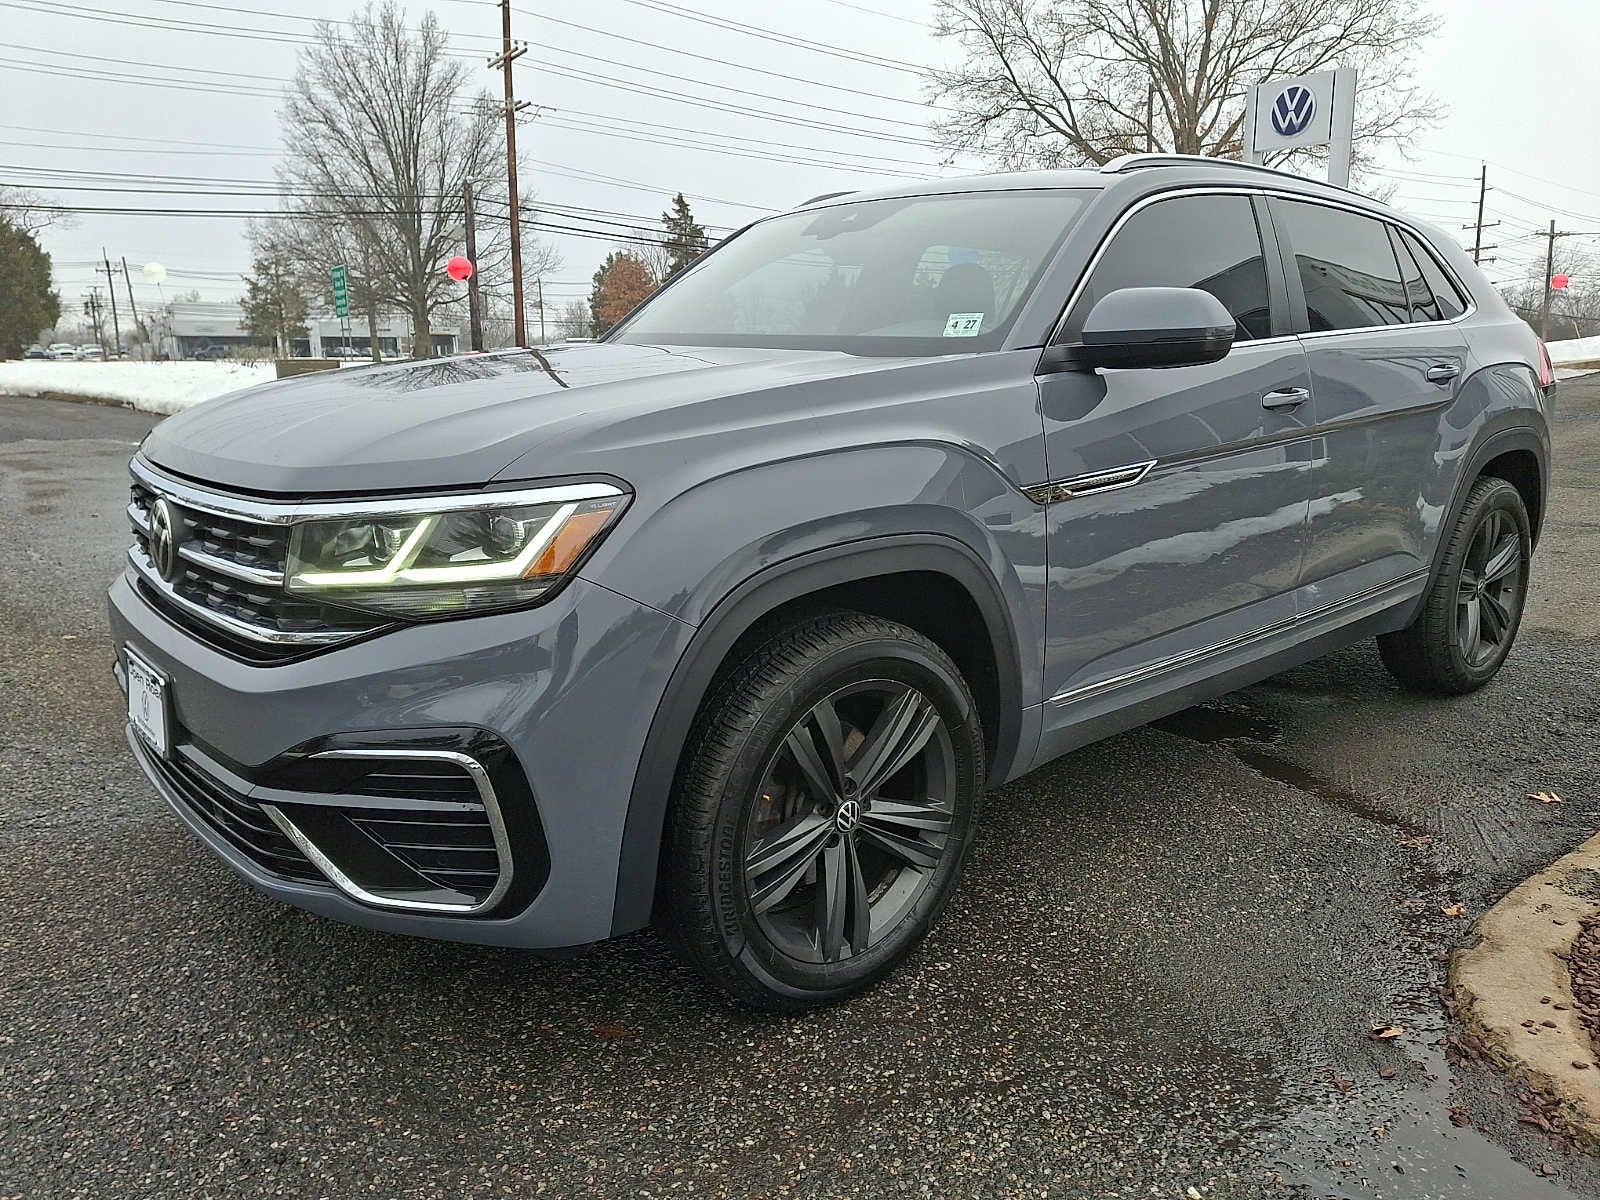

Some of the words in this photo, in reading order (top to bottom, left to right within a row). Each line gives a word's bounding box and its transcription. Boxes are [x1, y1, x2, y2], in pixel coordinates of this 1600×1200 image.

[1271, 85, 1317, 136] VW
[964, 320, 977, 329] 27
[838, 801, 860, 831] VW
